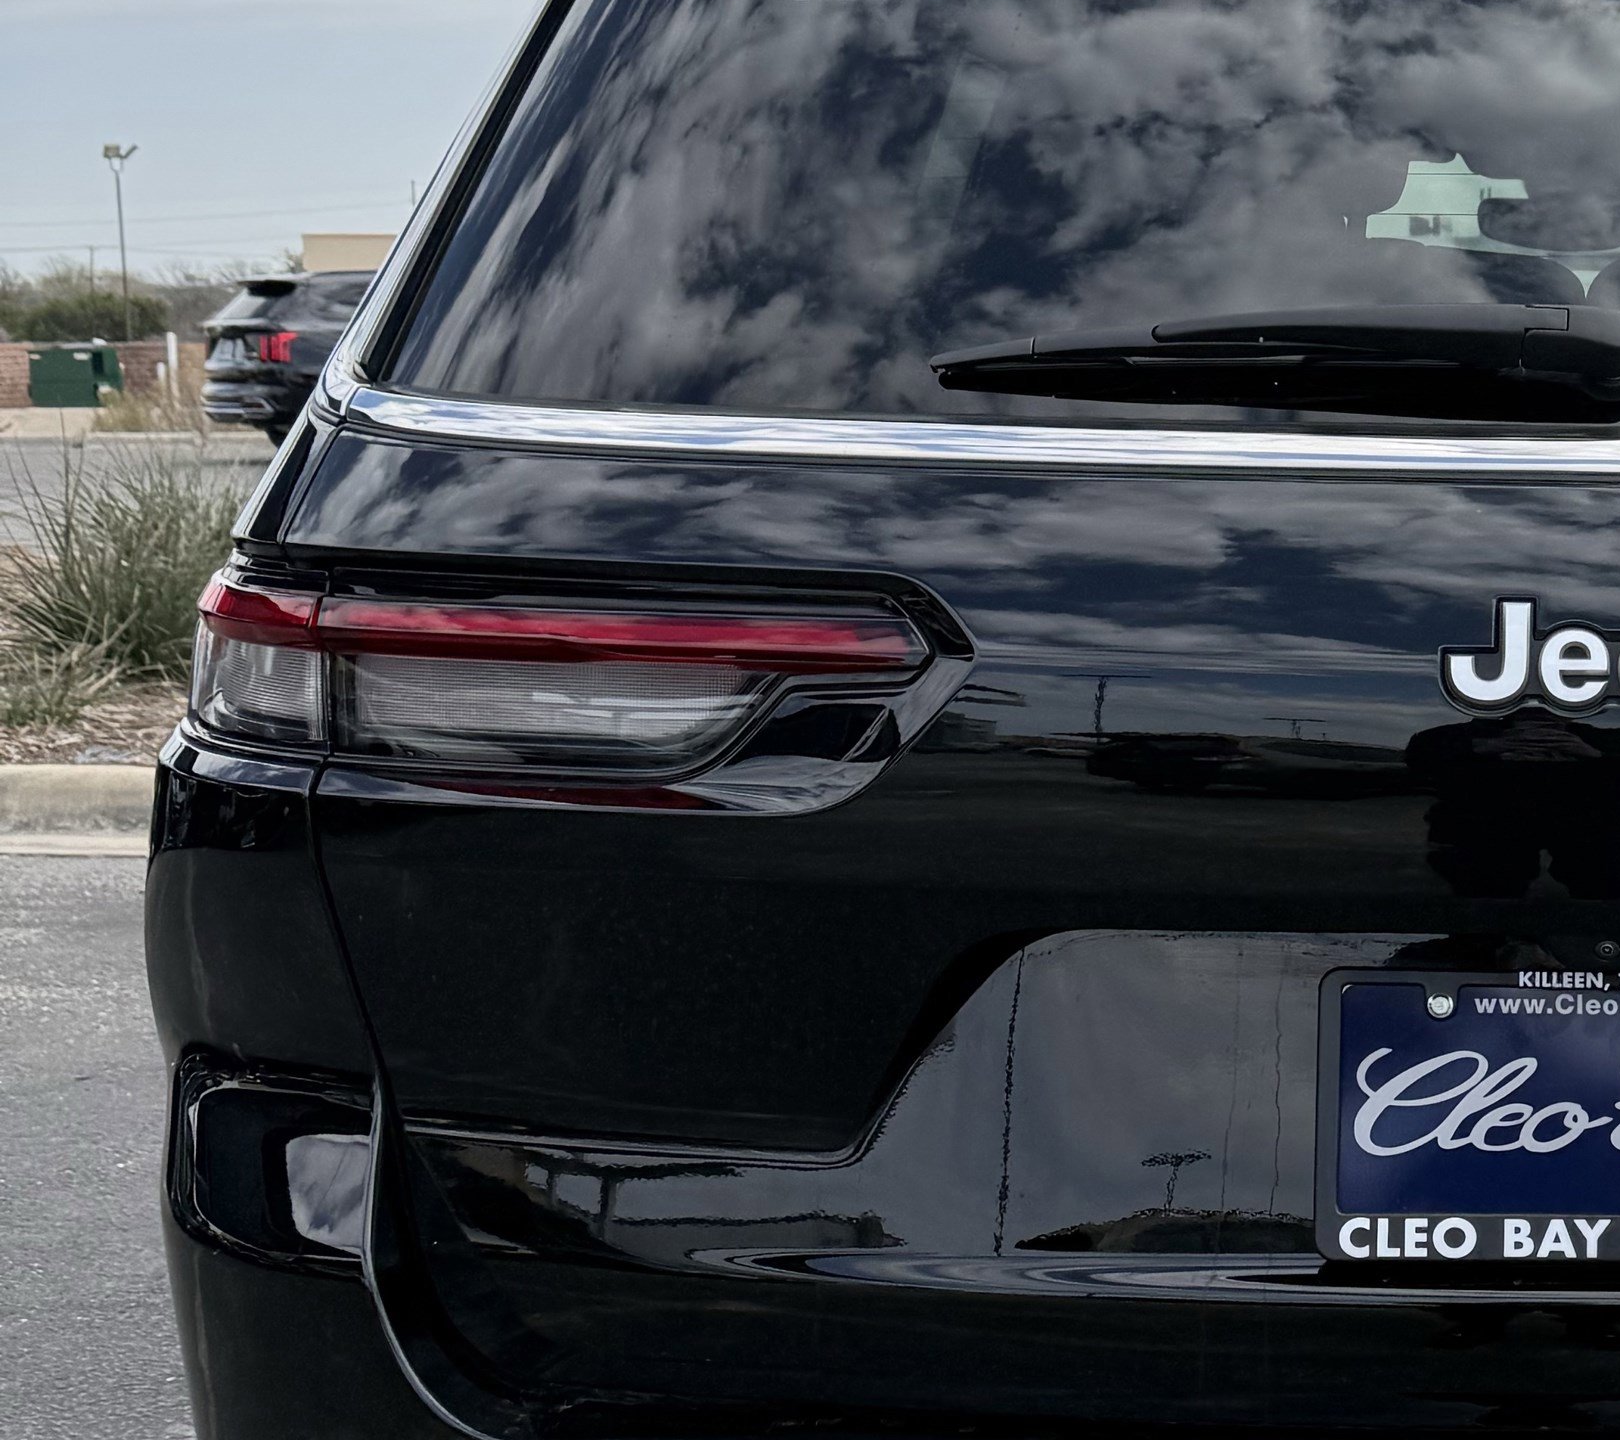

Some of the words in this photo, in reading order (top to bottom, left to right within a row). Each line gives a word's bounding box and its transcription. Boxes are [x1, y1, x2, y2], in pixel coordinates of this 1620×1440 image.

[1517, 971, 1611, 991] KILLEEN,
[1353, 1047, 1612, 1157] Cleo
[1337, 1216, 1478, 1260] CLEO
[1502, 1217, 1612, 1260] BAY
